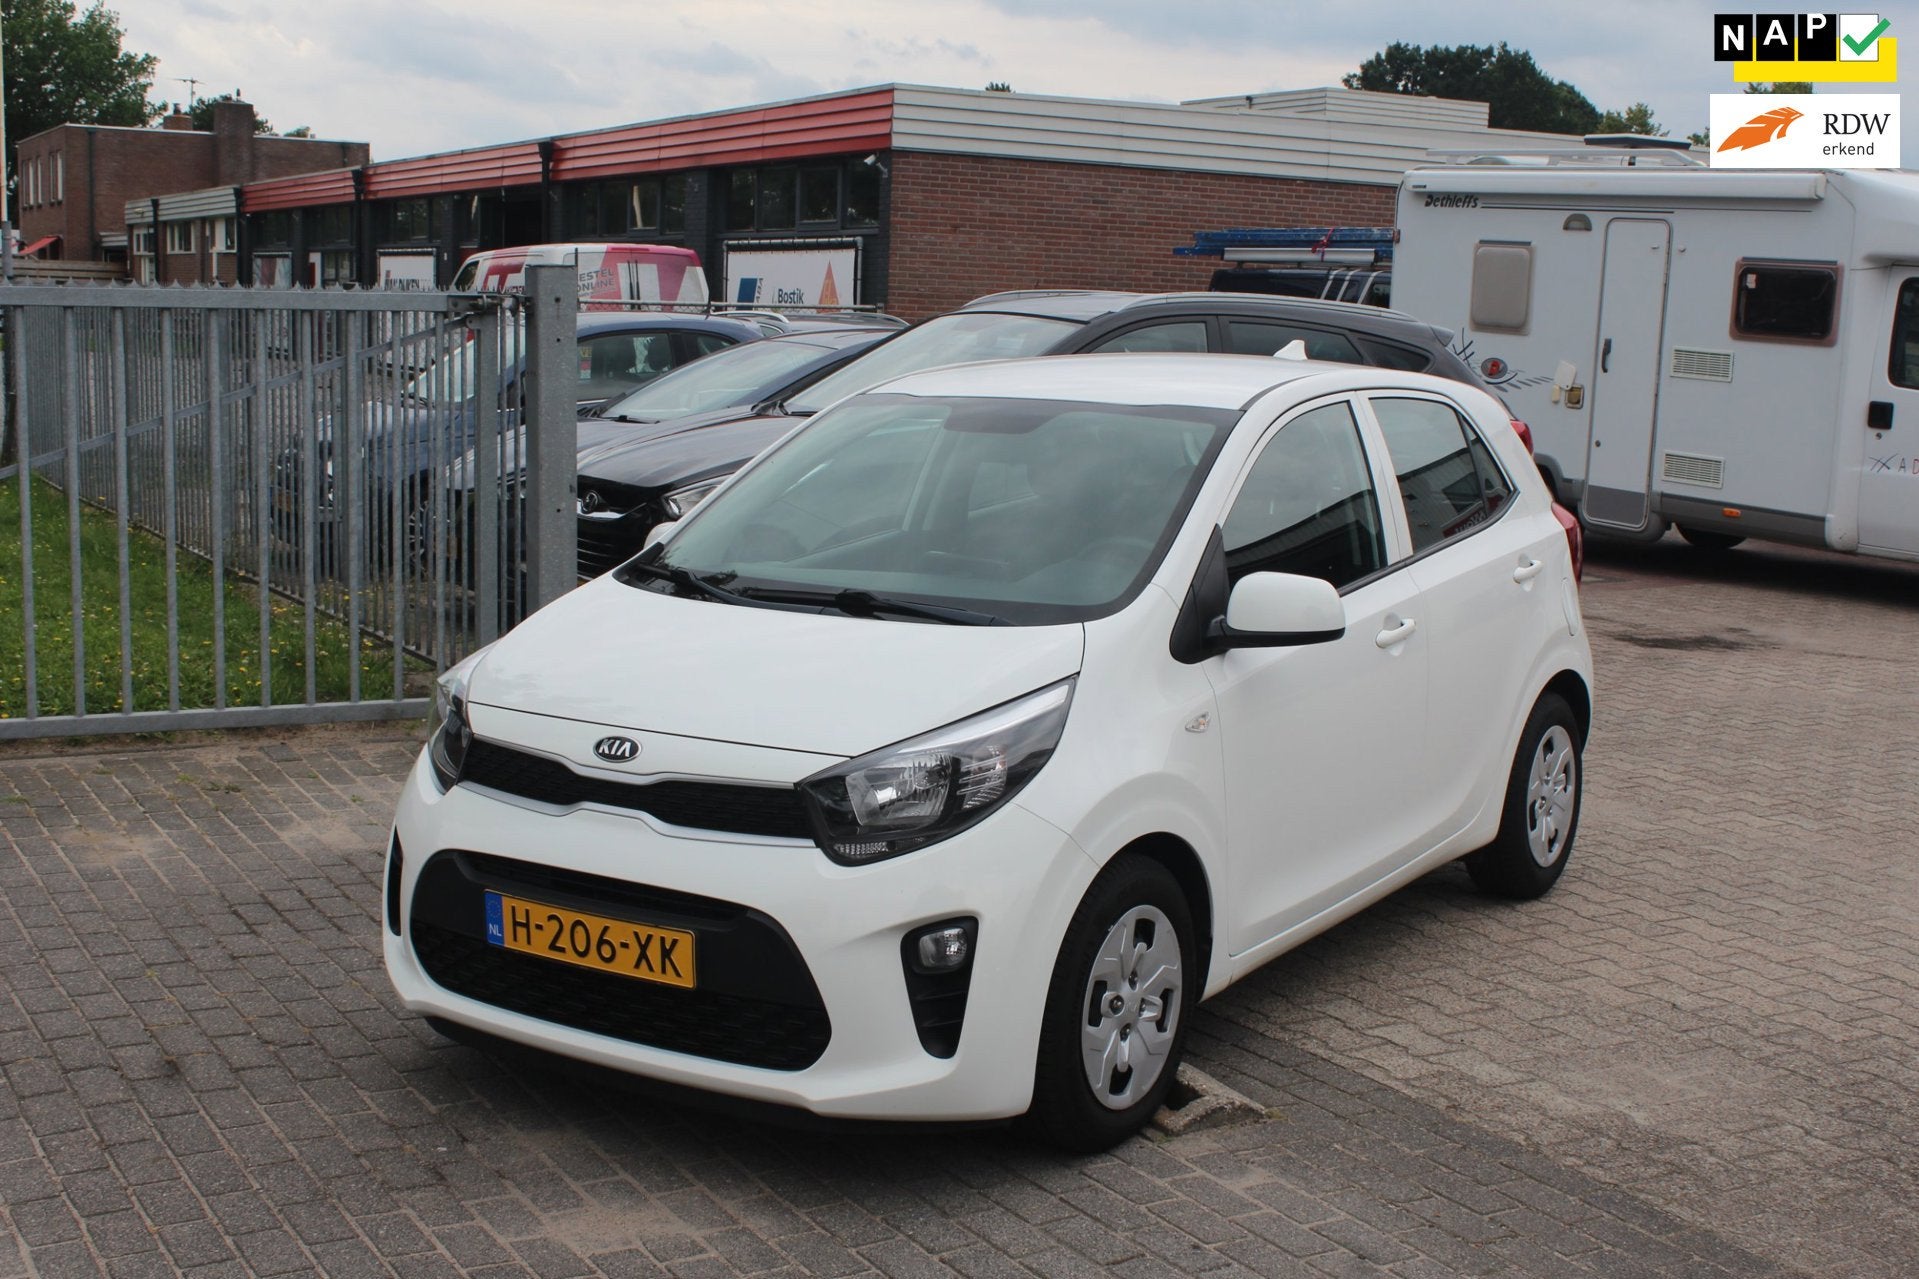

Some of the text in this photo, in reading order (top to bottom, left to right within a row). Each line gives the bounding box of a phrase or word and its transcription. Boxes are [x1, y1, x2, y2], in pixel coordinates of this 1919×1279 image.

[1425, 194, 1479, 208] Dethleffs
[578, 268, 614, 282] ESTEL
[777, 288, 805, 305] Bostik
[598, 738, 632, 758] KIA
[488, 905, 683, 978] NL H-206-XK
